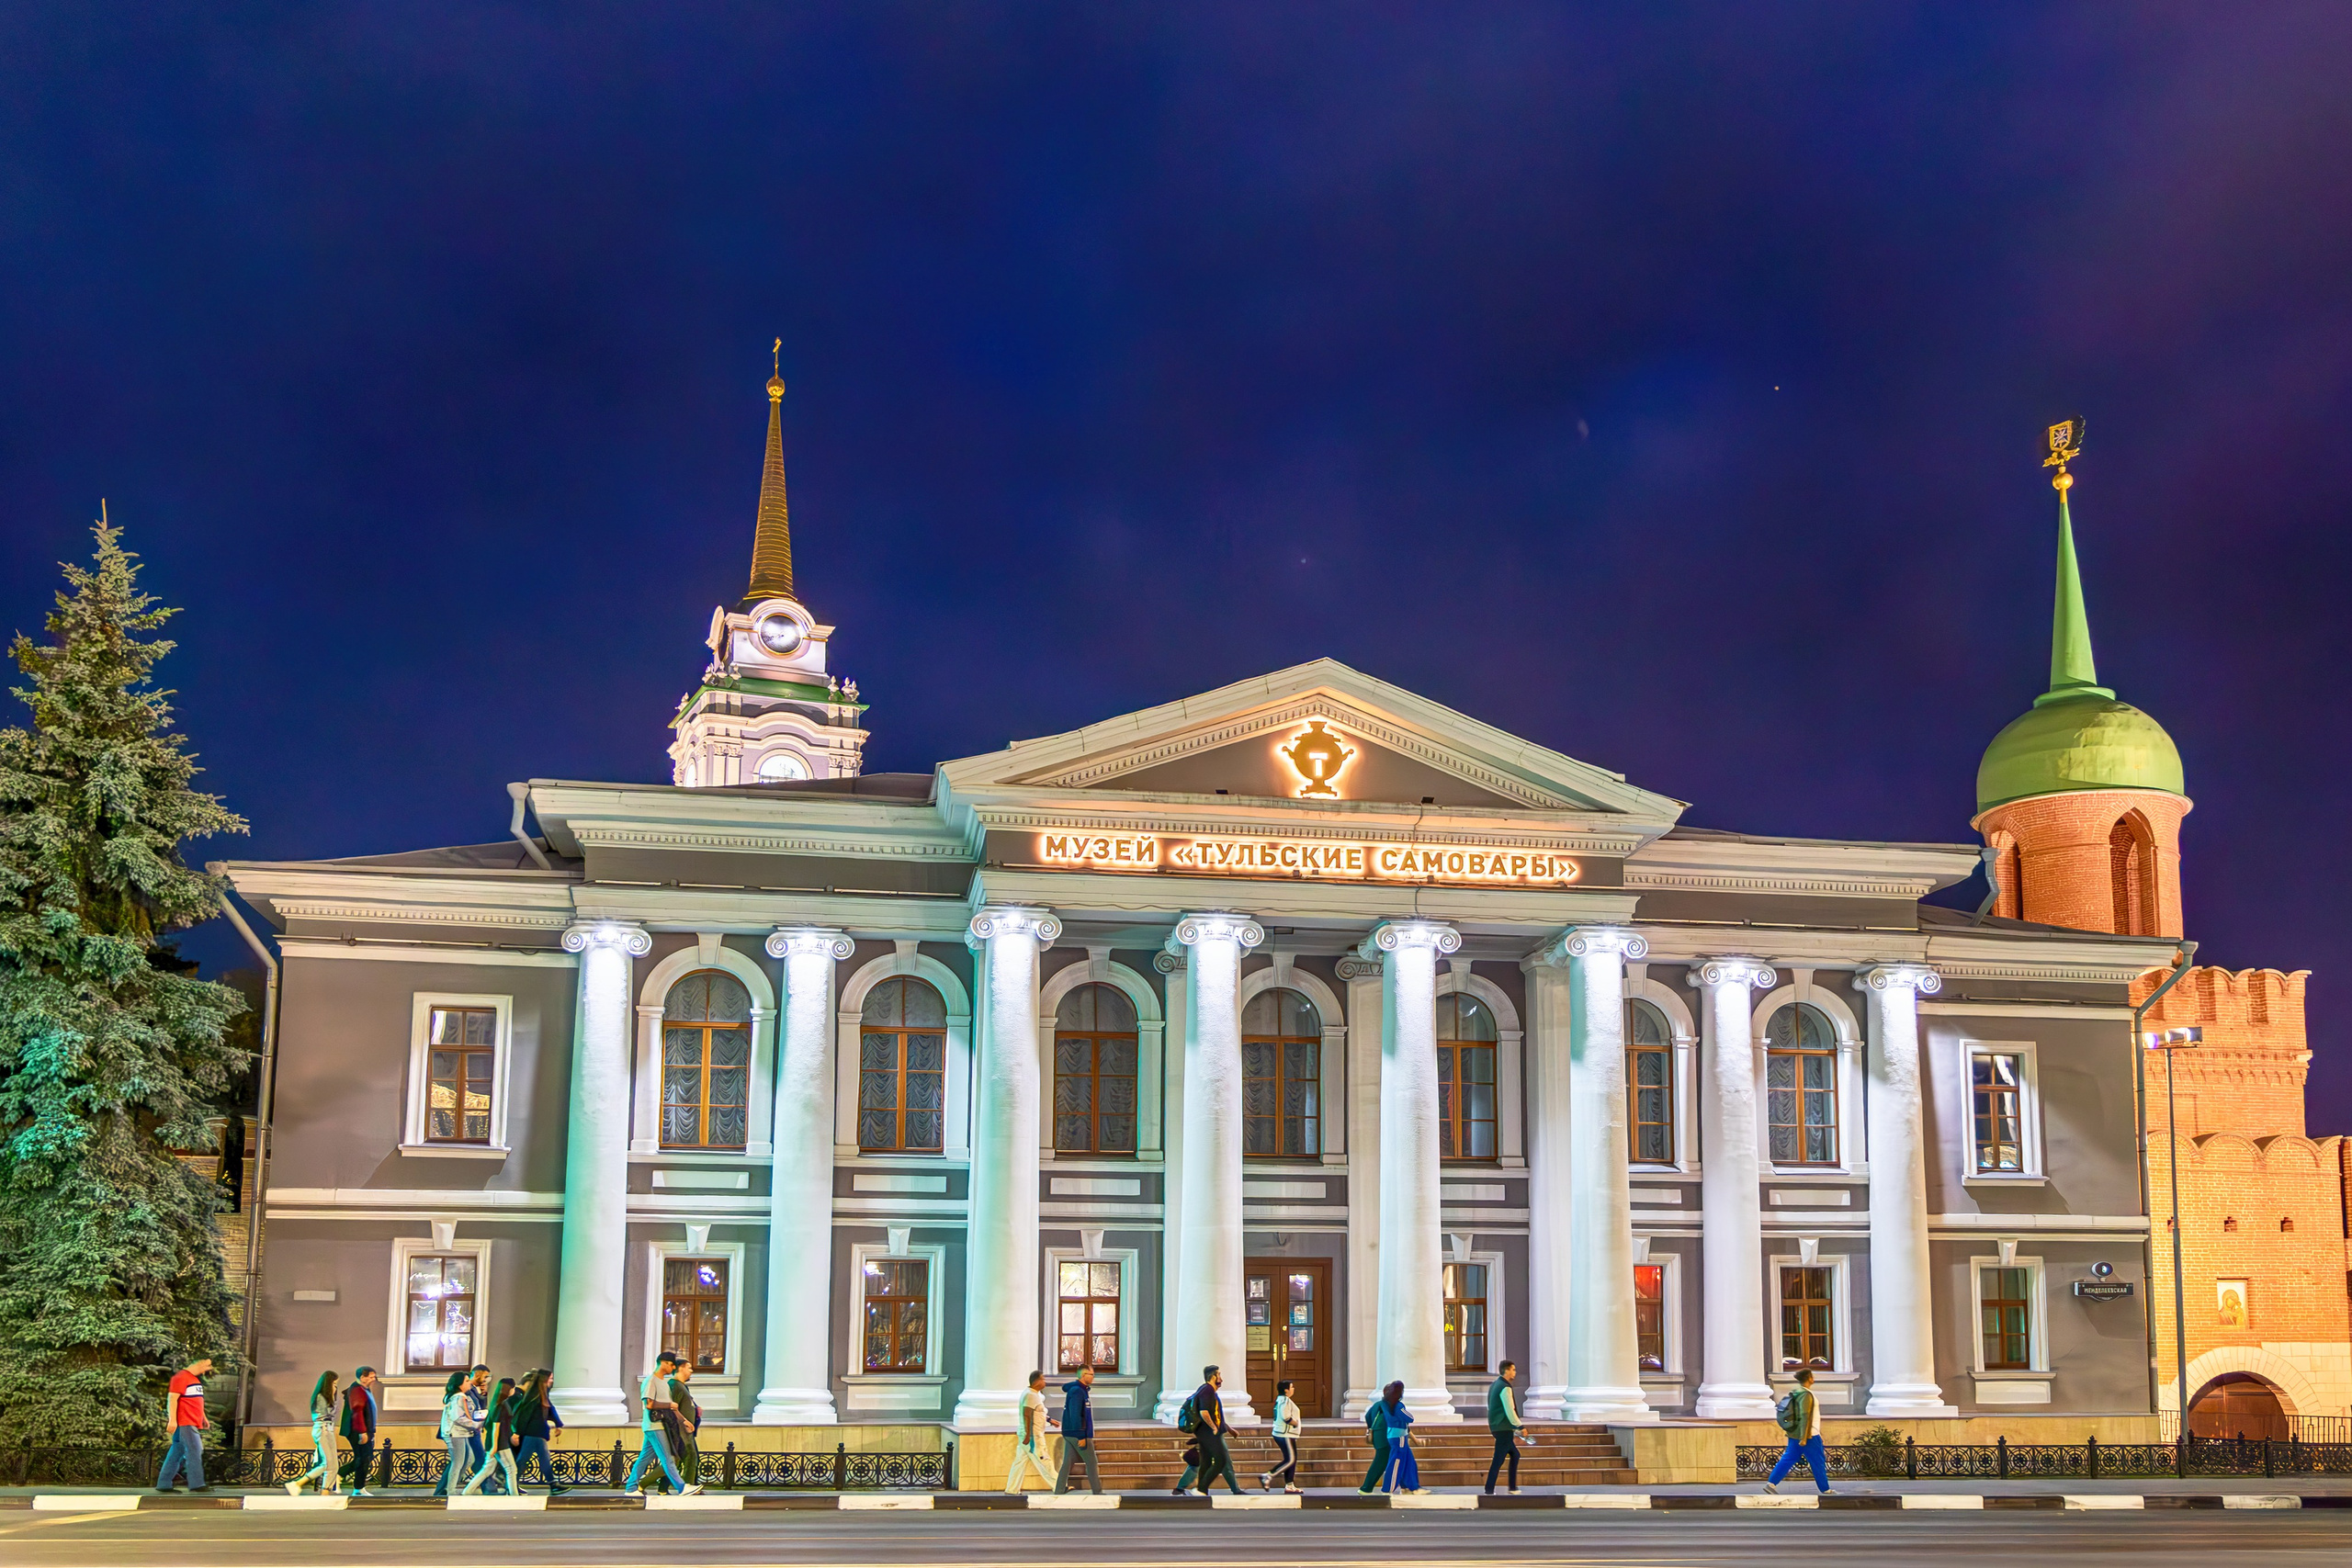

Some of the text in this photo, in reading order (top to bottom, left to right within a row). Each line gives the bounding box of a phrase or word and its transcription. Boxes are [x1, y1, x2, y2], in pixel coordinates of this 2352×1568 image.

[1046, 835, 1577, 877] МУЗЕЙ «ТУЛЬСКИЕ САМОВАРЫ»
